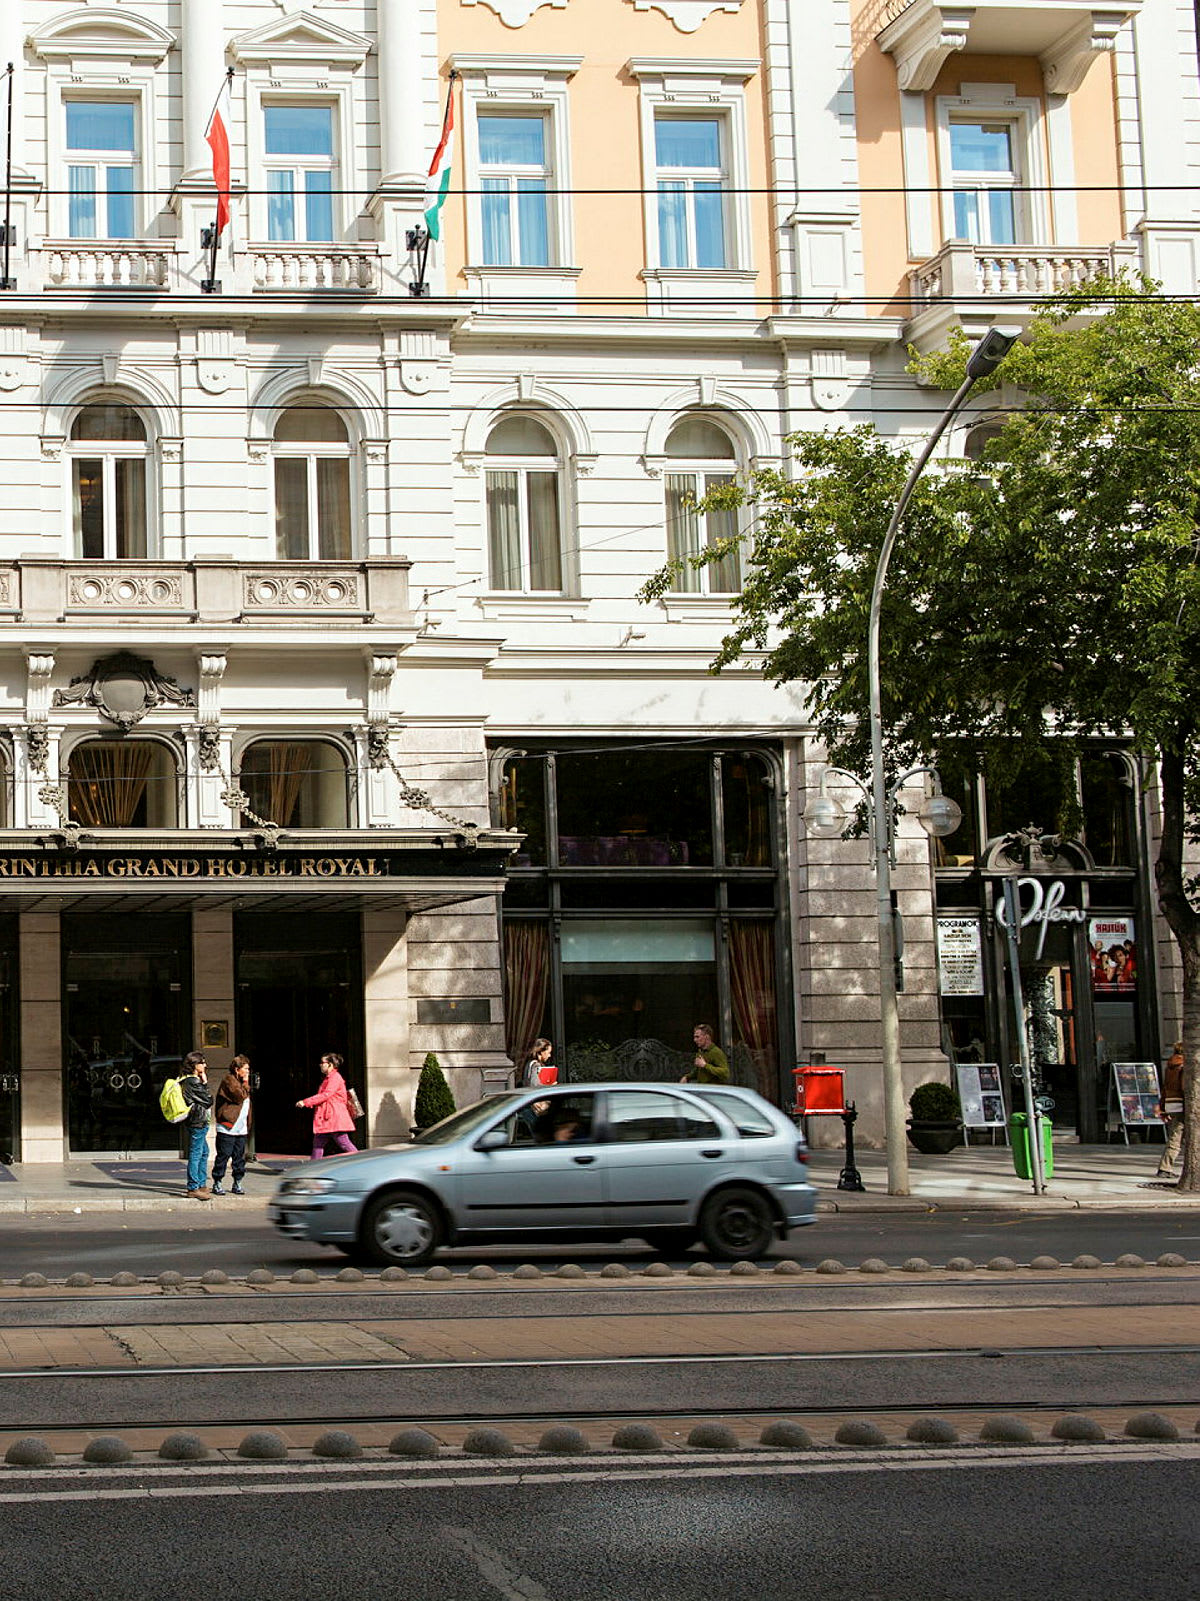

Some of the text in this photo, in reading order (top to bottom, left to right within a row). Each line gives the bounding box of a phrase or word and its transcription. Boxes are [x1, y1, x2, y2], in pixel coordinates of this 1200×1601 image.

[107, 858, 200, 877] GRAND
[207, 858, 293, 878] HOTEL
[299, 858, 382, 877] ROYAL
